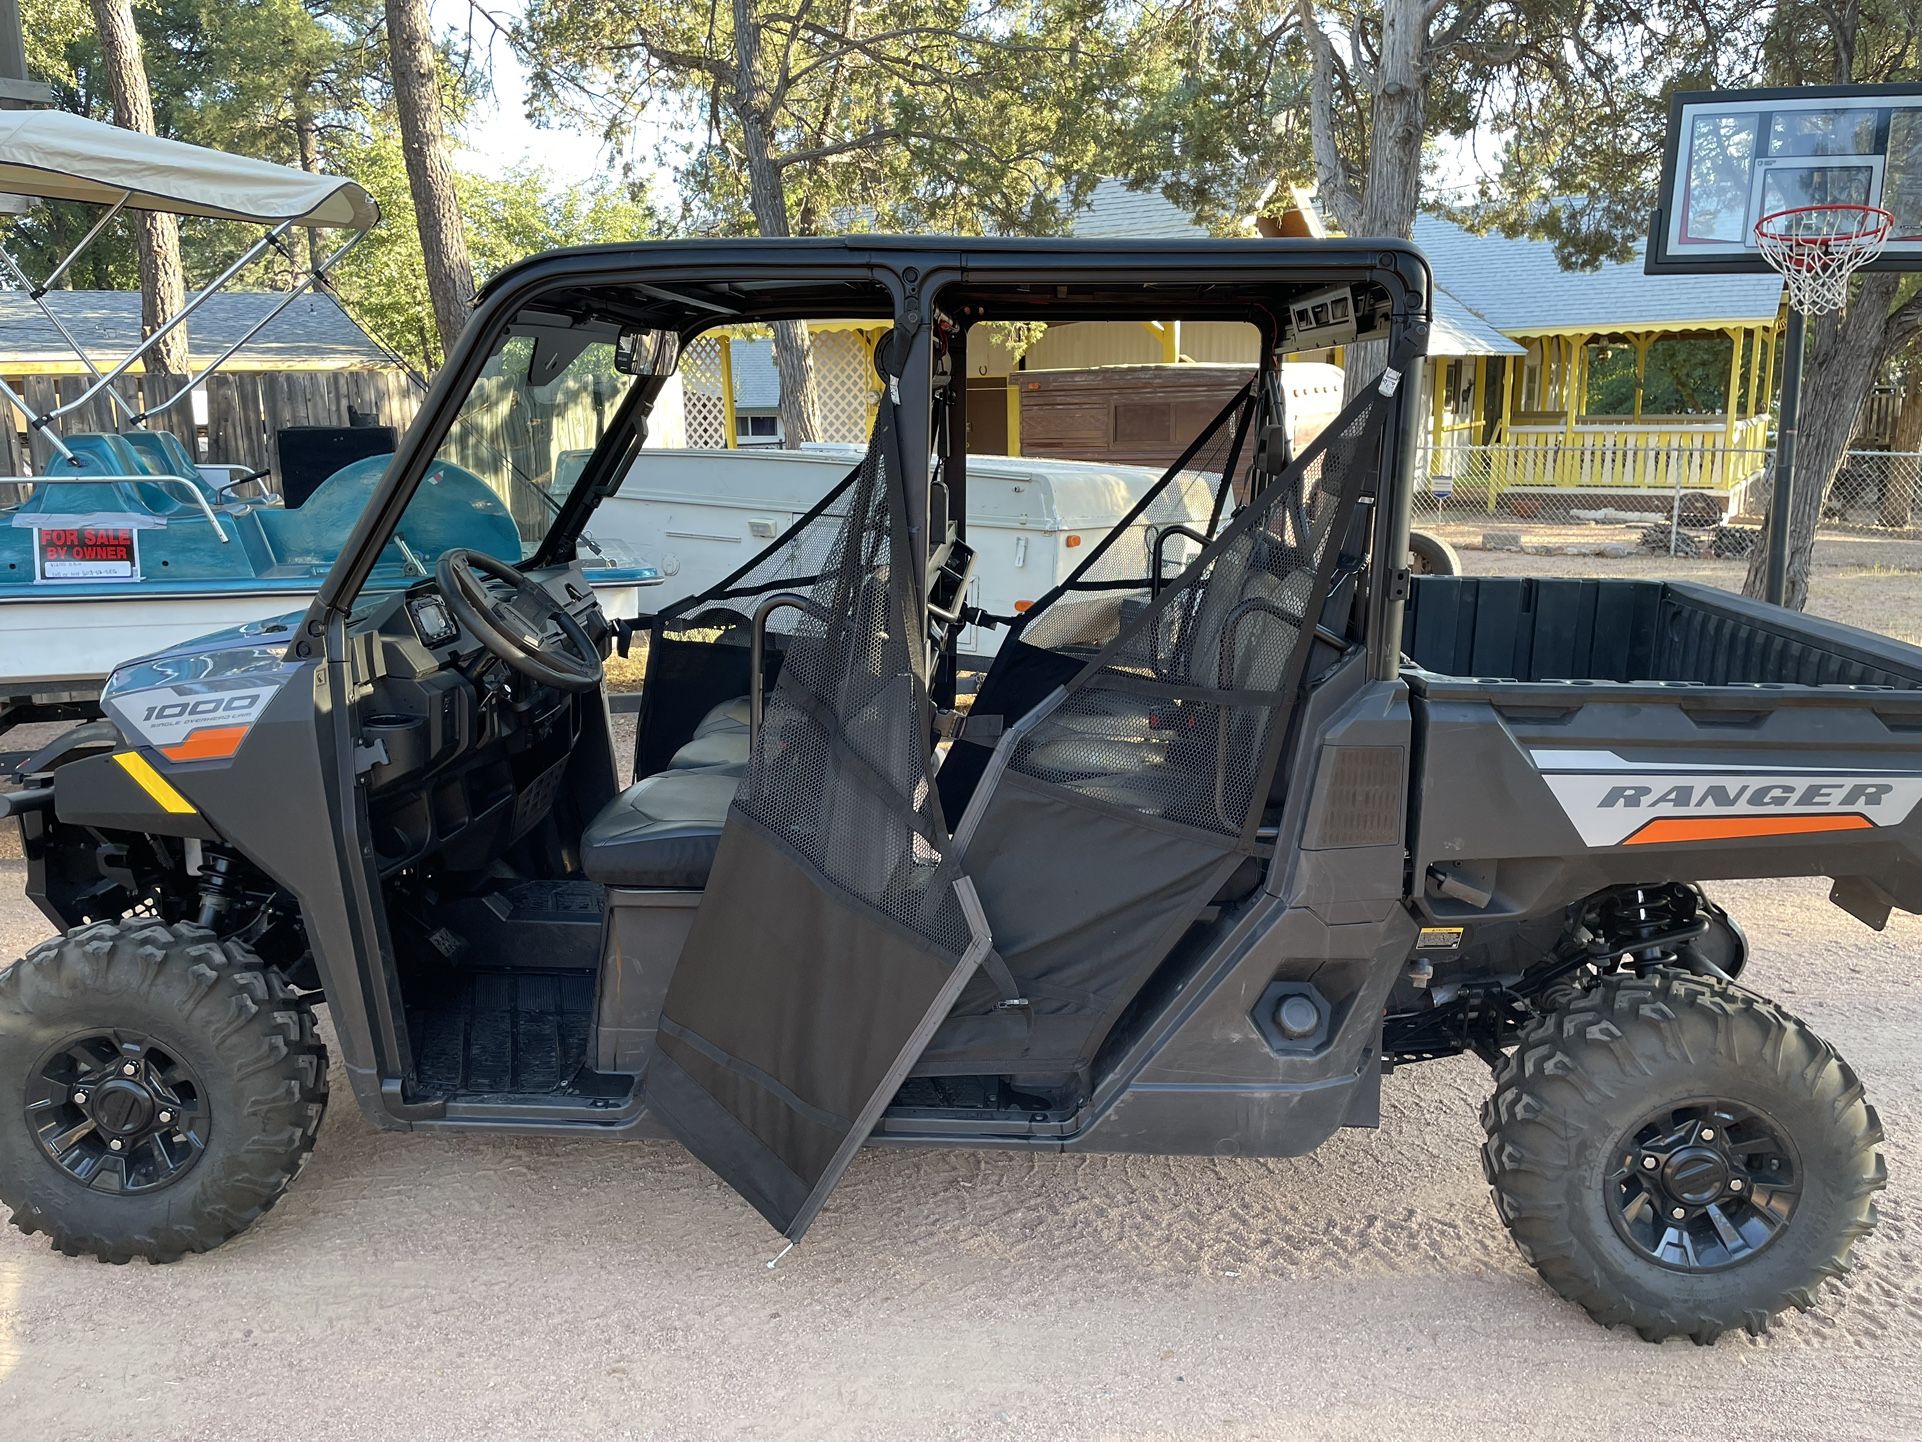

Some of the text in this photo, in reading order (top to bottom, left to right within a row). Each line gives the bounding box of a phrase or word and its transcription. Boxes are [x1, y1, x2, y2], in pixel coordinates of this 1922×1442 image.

[41, 528, 131, 545] FOR SALE
[47, 546, 127, 560] BY OWNER
[143, 694, 260, 721] 1000
[151, 720, 181, 728] SINGLE
[1596, 783, 1894, 809] RANGER
